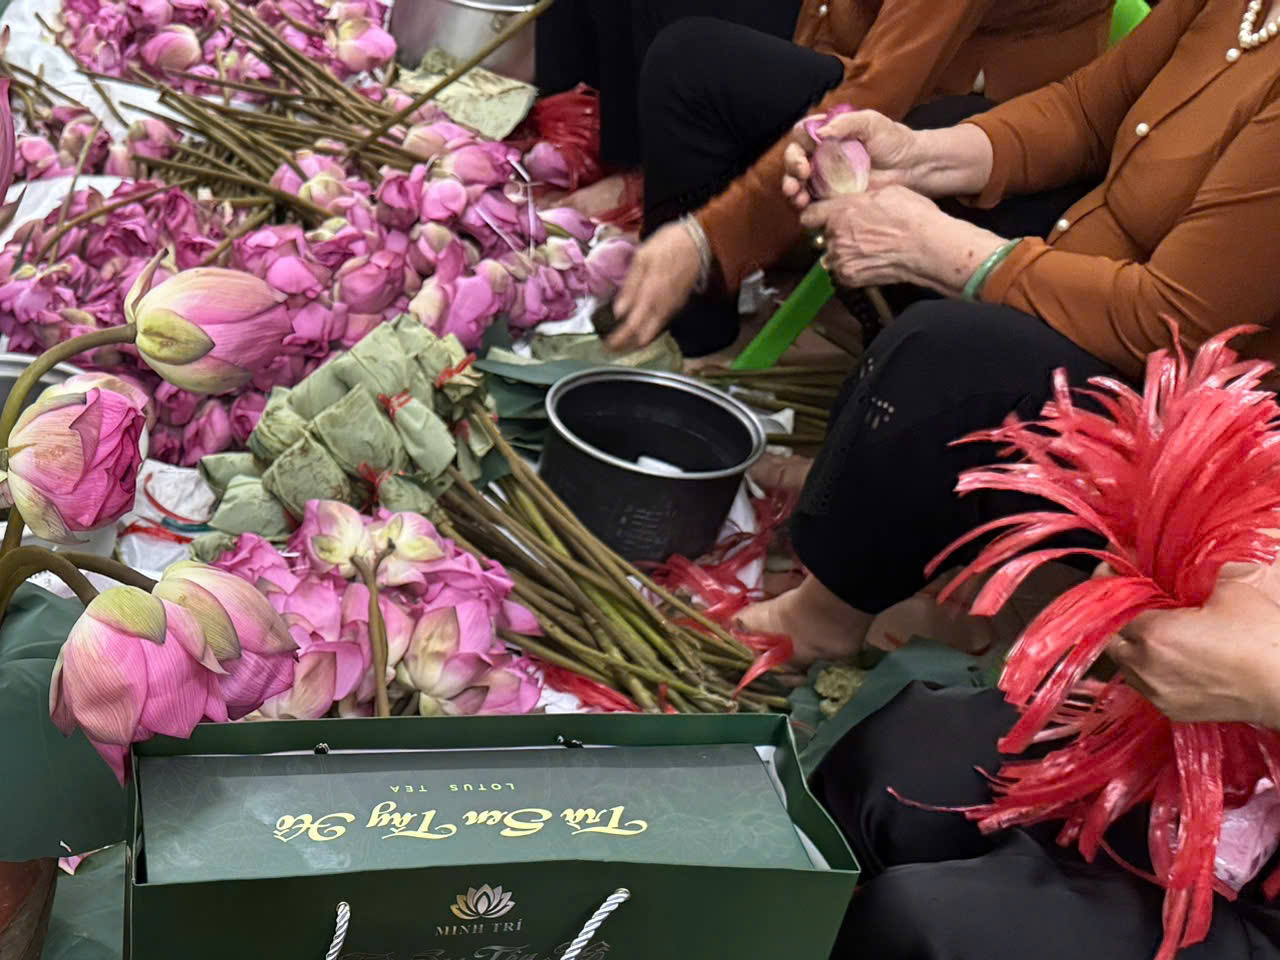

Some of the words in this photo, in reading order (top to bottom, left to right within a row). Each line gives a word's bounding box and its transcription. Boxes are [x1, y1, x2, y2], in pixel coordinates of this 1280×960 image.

[389, 784, 428, 792] TEA
[450, 783, 516, 792] LOTUS
[366, 800, 457, 840] Tây
[462, 808, 553, 837] Sen
[560, 806, 648, 836] Trà
[434, 924, 484, 936] MINH
